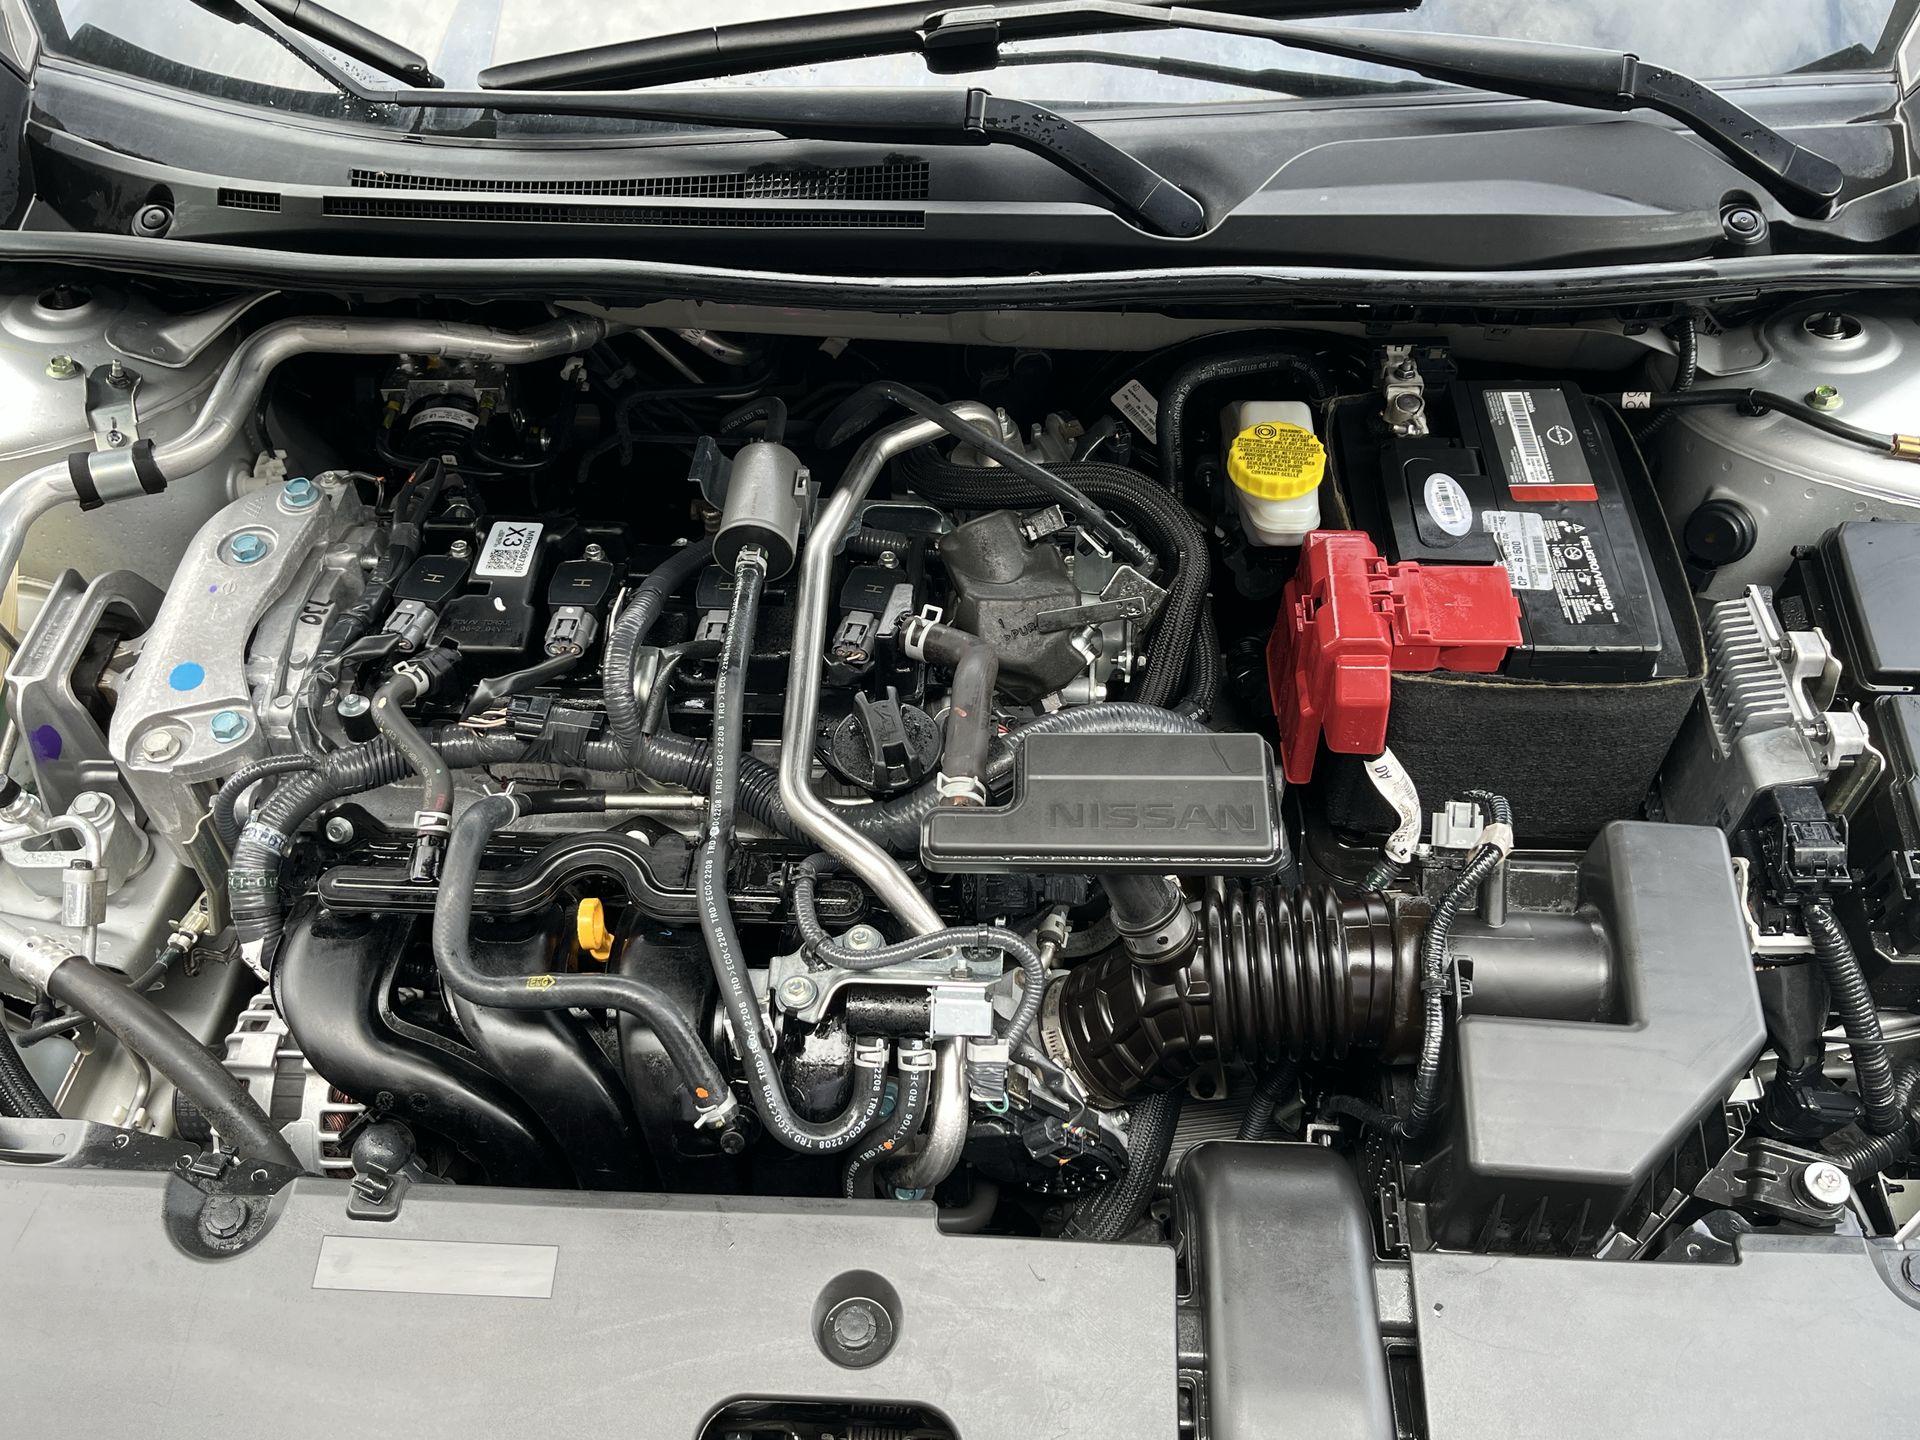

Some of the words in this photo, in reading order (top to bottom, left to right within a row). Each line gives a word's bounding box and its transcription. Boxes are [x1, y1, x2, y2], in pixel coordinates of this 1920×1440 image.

[1554, 424, 1565, 445] NISSAN
[503, 526, 527, 547] X3
[1580, 535, 1613, 610] PELIGRO/VENENO
[715, 725, 725, 795] TRD>ECO<2208
[707, 799, 722, 855] TRD>O<2208
[1050, 802, 1256, 832] NISSAN
[704, 860, 719, 923] TRD>ECO<2208
[530, 978, 548, 987] ENG
[715, 926, 743, 996] TRD>ECO<2208
[762, 1084, 813, 1148] TRD>ECO<2208
[860, 1113, 913, 1161] TRD>EO<1Y06
